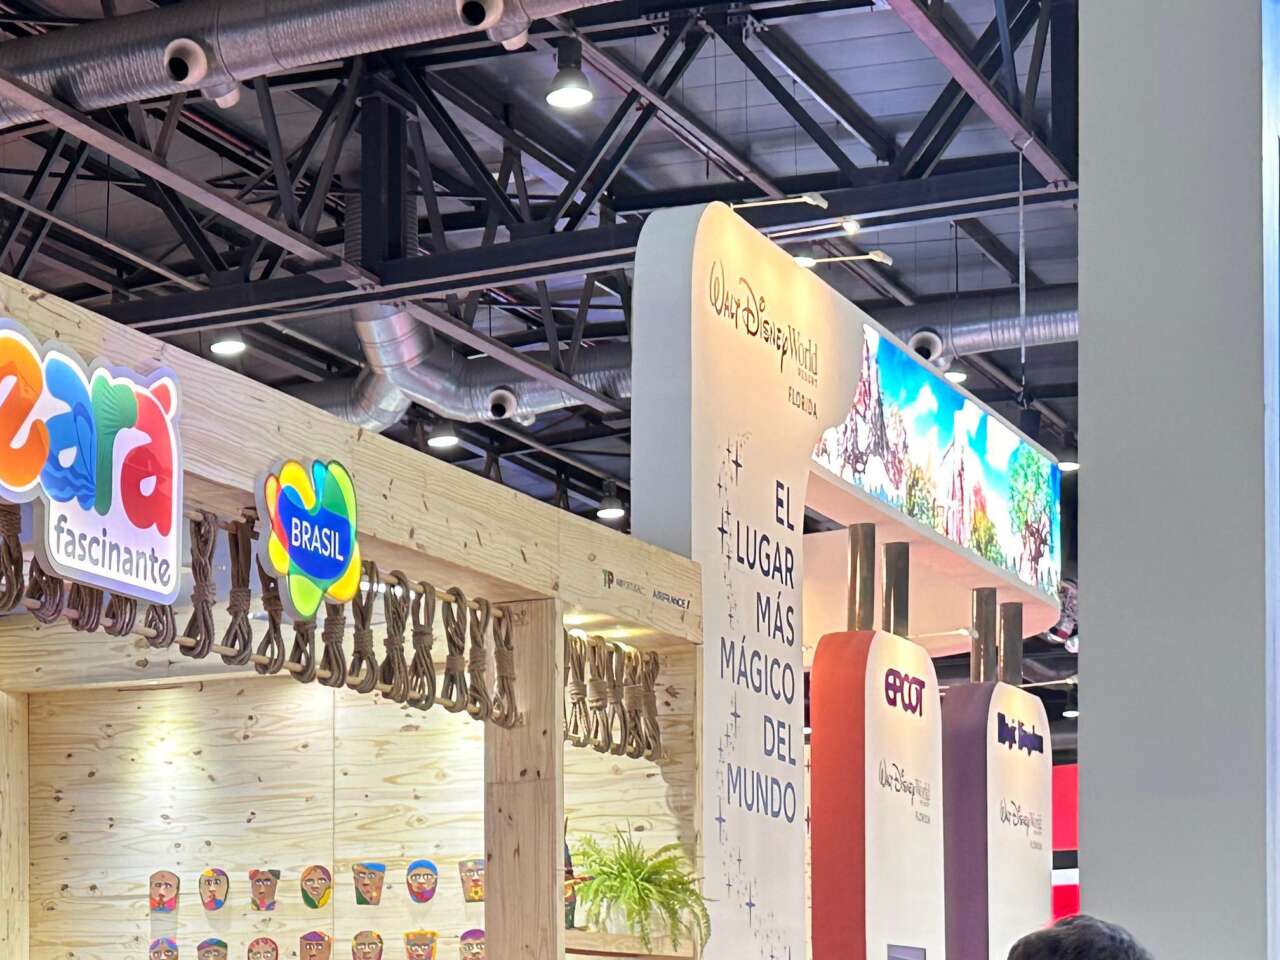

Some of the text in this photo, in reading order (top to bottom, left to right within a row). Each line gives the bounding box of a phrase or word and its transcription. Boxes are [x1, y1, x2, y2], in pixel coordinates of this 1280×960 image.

[787, 325, 818, 376] World
[788, 385, 818, 420] FLORIDA
[775, 479, 795, 531] EL
[54, 514, 171, 588] fascinante
[290, 516, 345, 563] BRASIL
[735, 519, 795, 590] LUGAR
[756, 591, 796, 648] MÁS
[720, 635, 796, 705] MÁGICO
[763, 714, 797, 767] DEL
[726, 761, 797, 824] MUNDO
